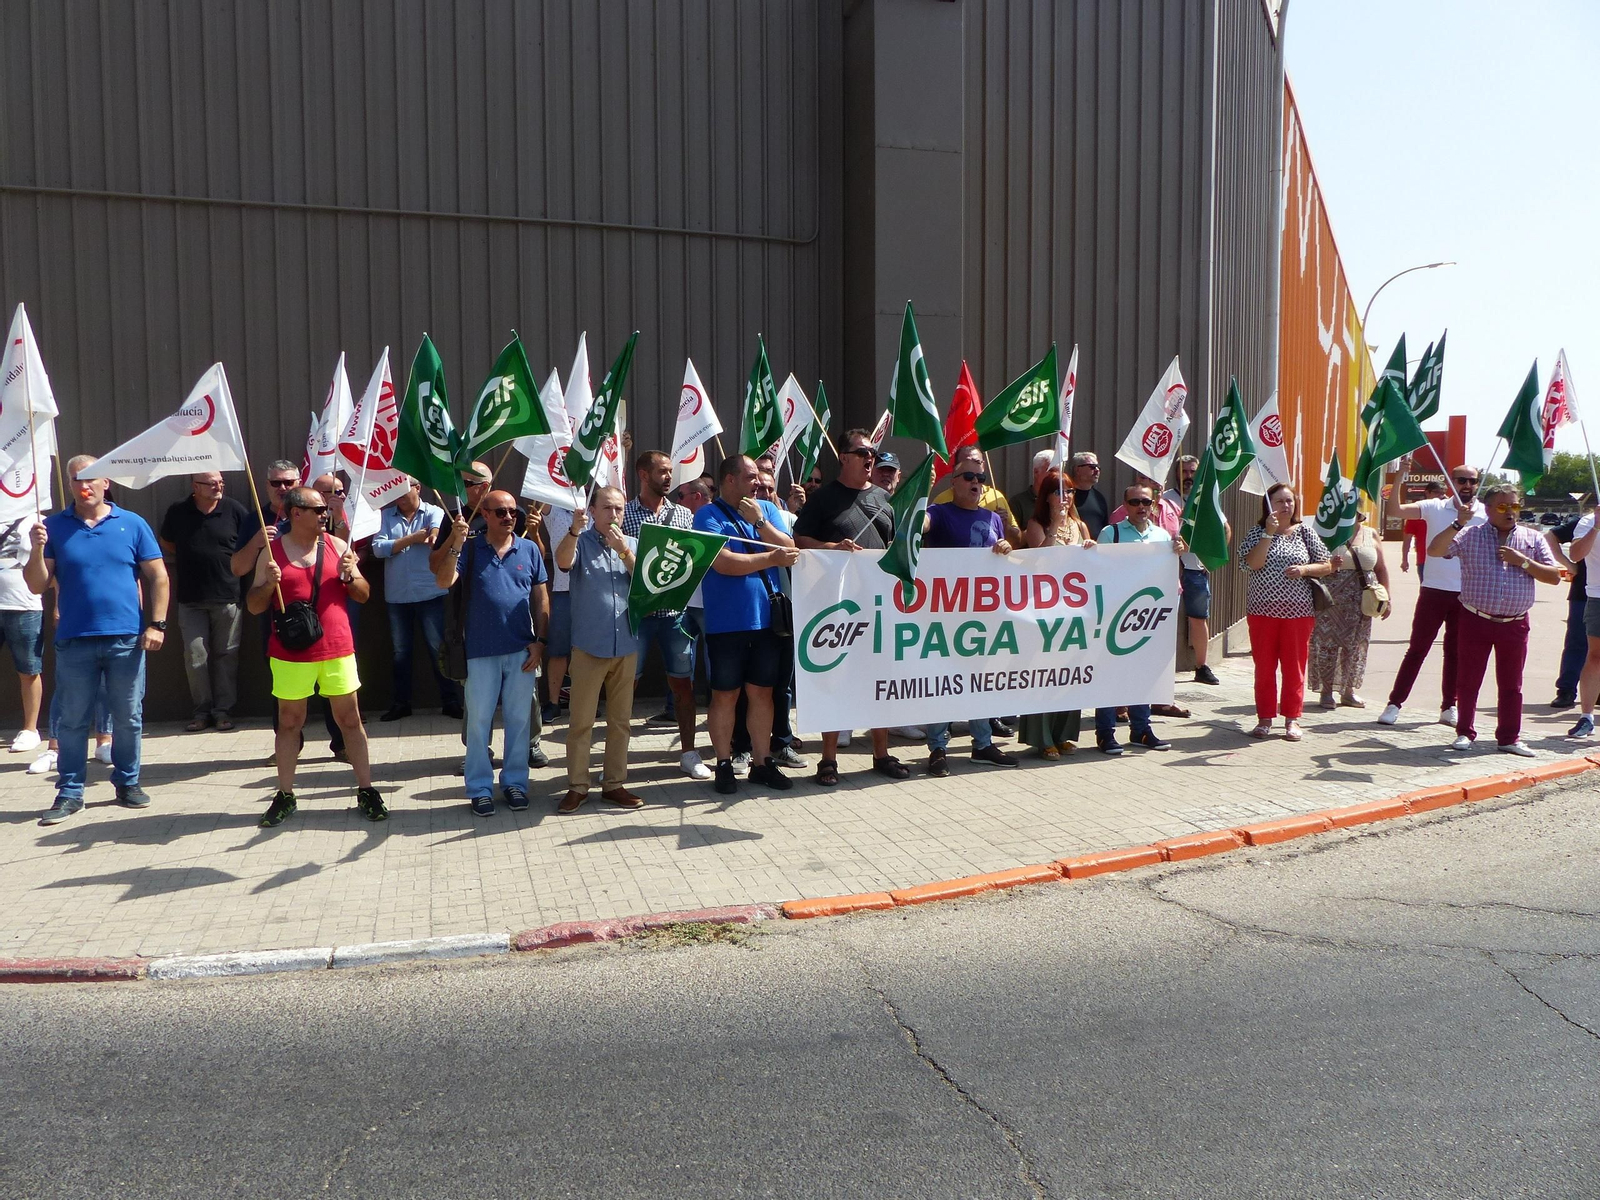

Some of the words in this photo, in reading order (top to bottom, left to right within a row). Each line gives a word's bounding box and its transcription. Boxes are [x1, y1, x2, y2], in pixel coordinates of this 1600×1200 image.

[1421, 474, 1446, 482] KING
[656, 537, 685, 586] CSIF
[892, 571, 1089, 613] OMBUDS
[811, 621, 870, 649] CSIF
[1119, 607, 1174, 633] CSIF
[874, 673, 964, 701] FAMILIAS
[969, 664, 1094, 694] NECESITADAS
